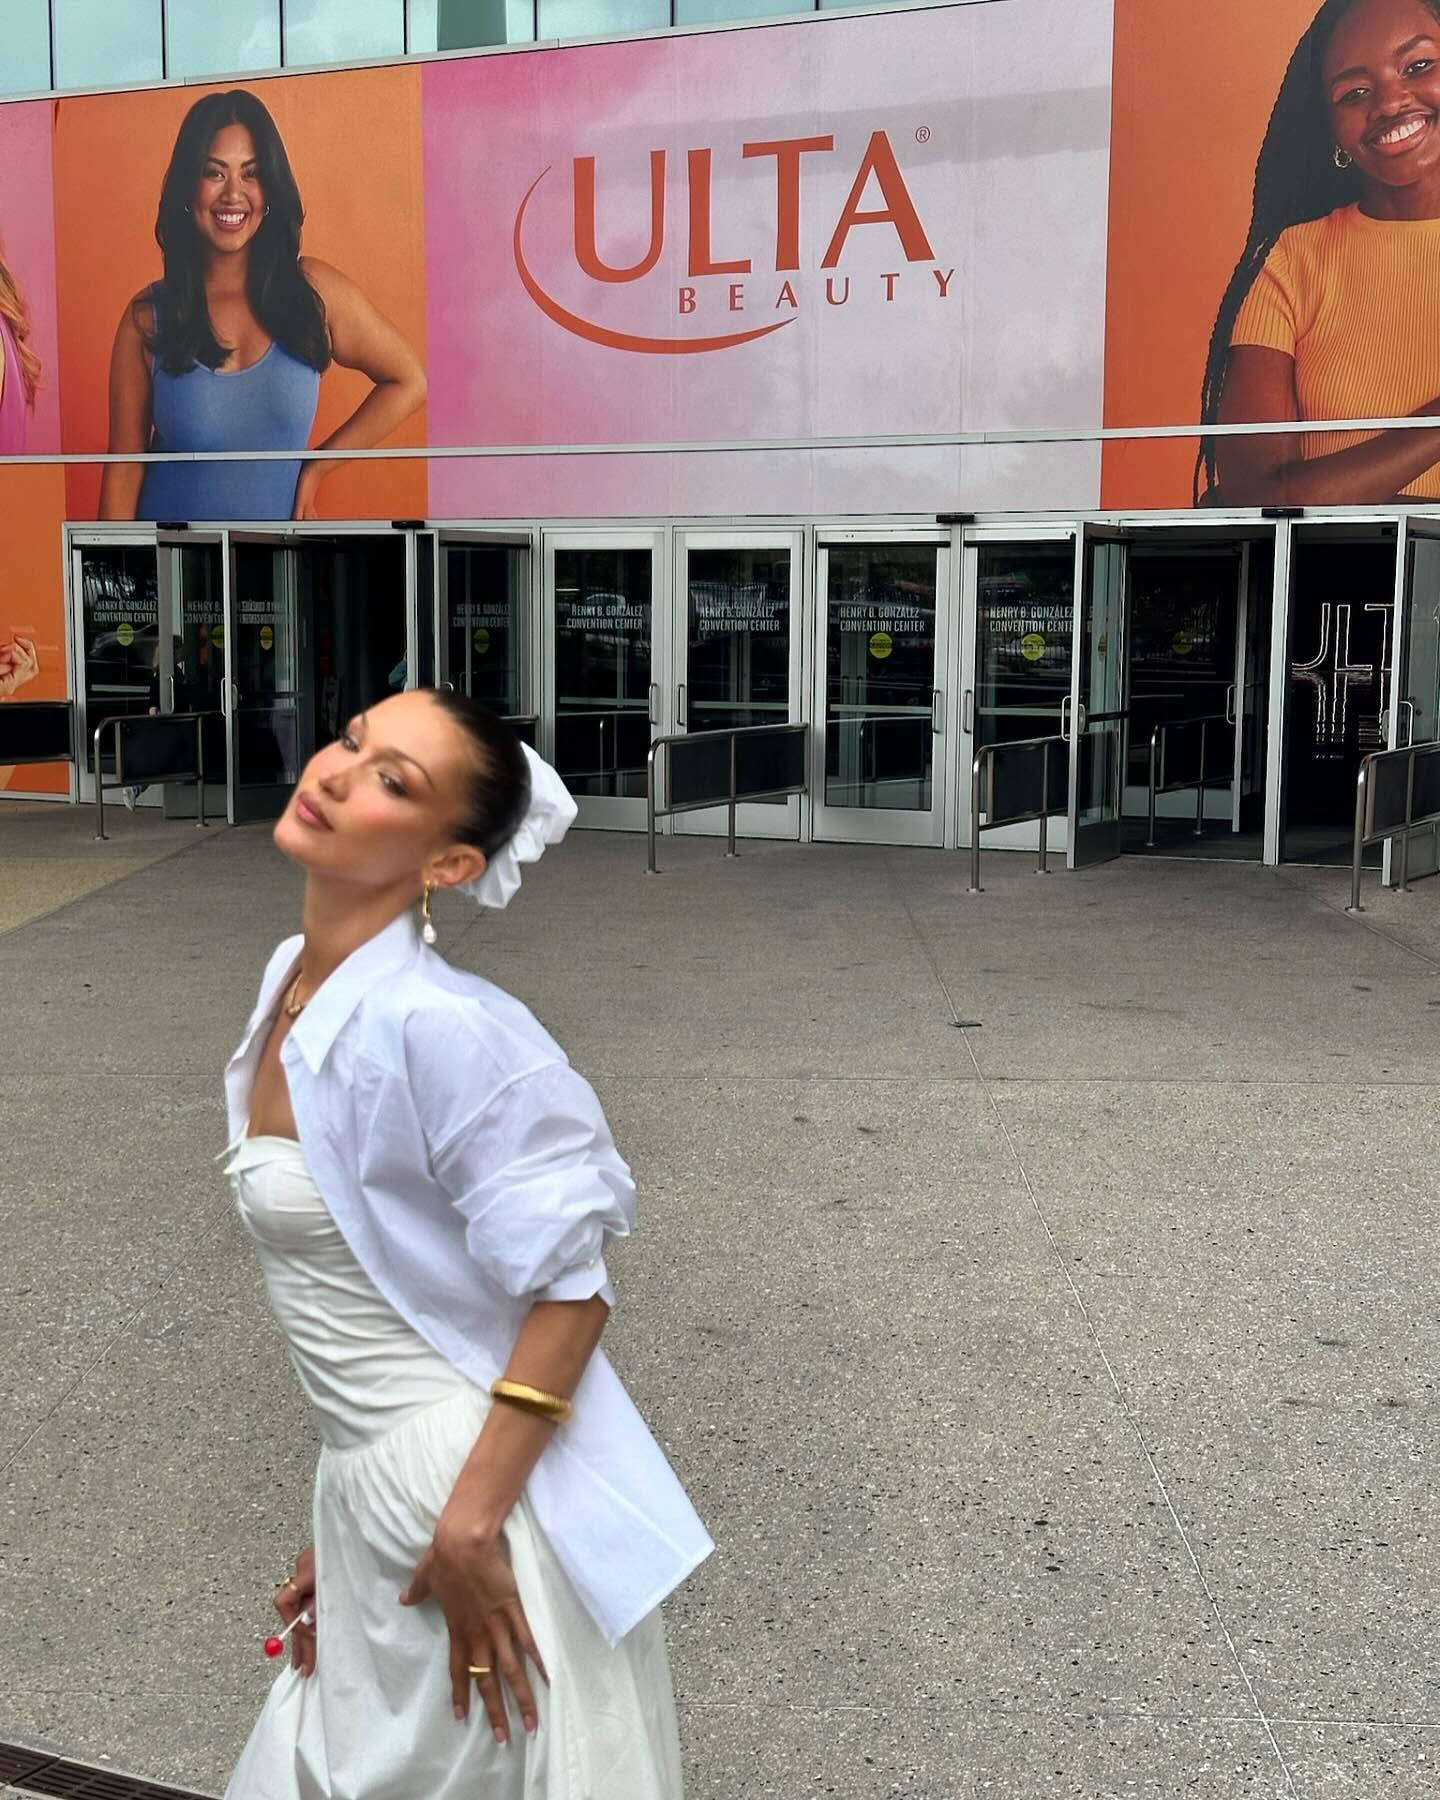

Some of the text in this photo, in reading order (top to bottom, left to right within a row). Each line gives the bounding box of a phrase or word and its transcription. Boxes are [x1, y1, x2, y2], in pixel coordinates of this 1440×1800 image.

[573, 130, 936, 283] ULTA
[678, 268, 955, 314] BEAUTY
[840, 606, 867, 618] HENRY
[990, 606, 1018, 618] HENRY
[566, 618, 643, 629] CONVENTION CENTER
[700, 619, 780, 631] CONVENTION CENTER
[840, 620, 925, 632] CONVENTION CENTER
[990, 620, 1073, 632] CONVENTION CENTE
